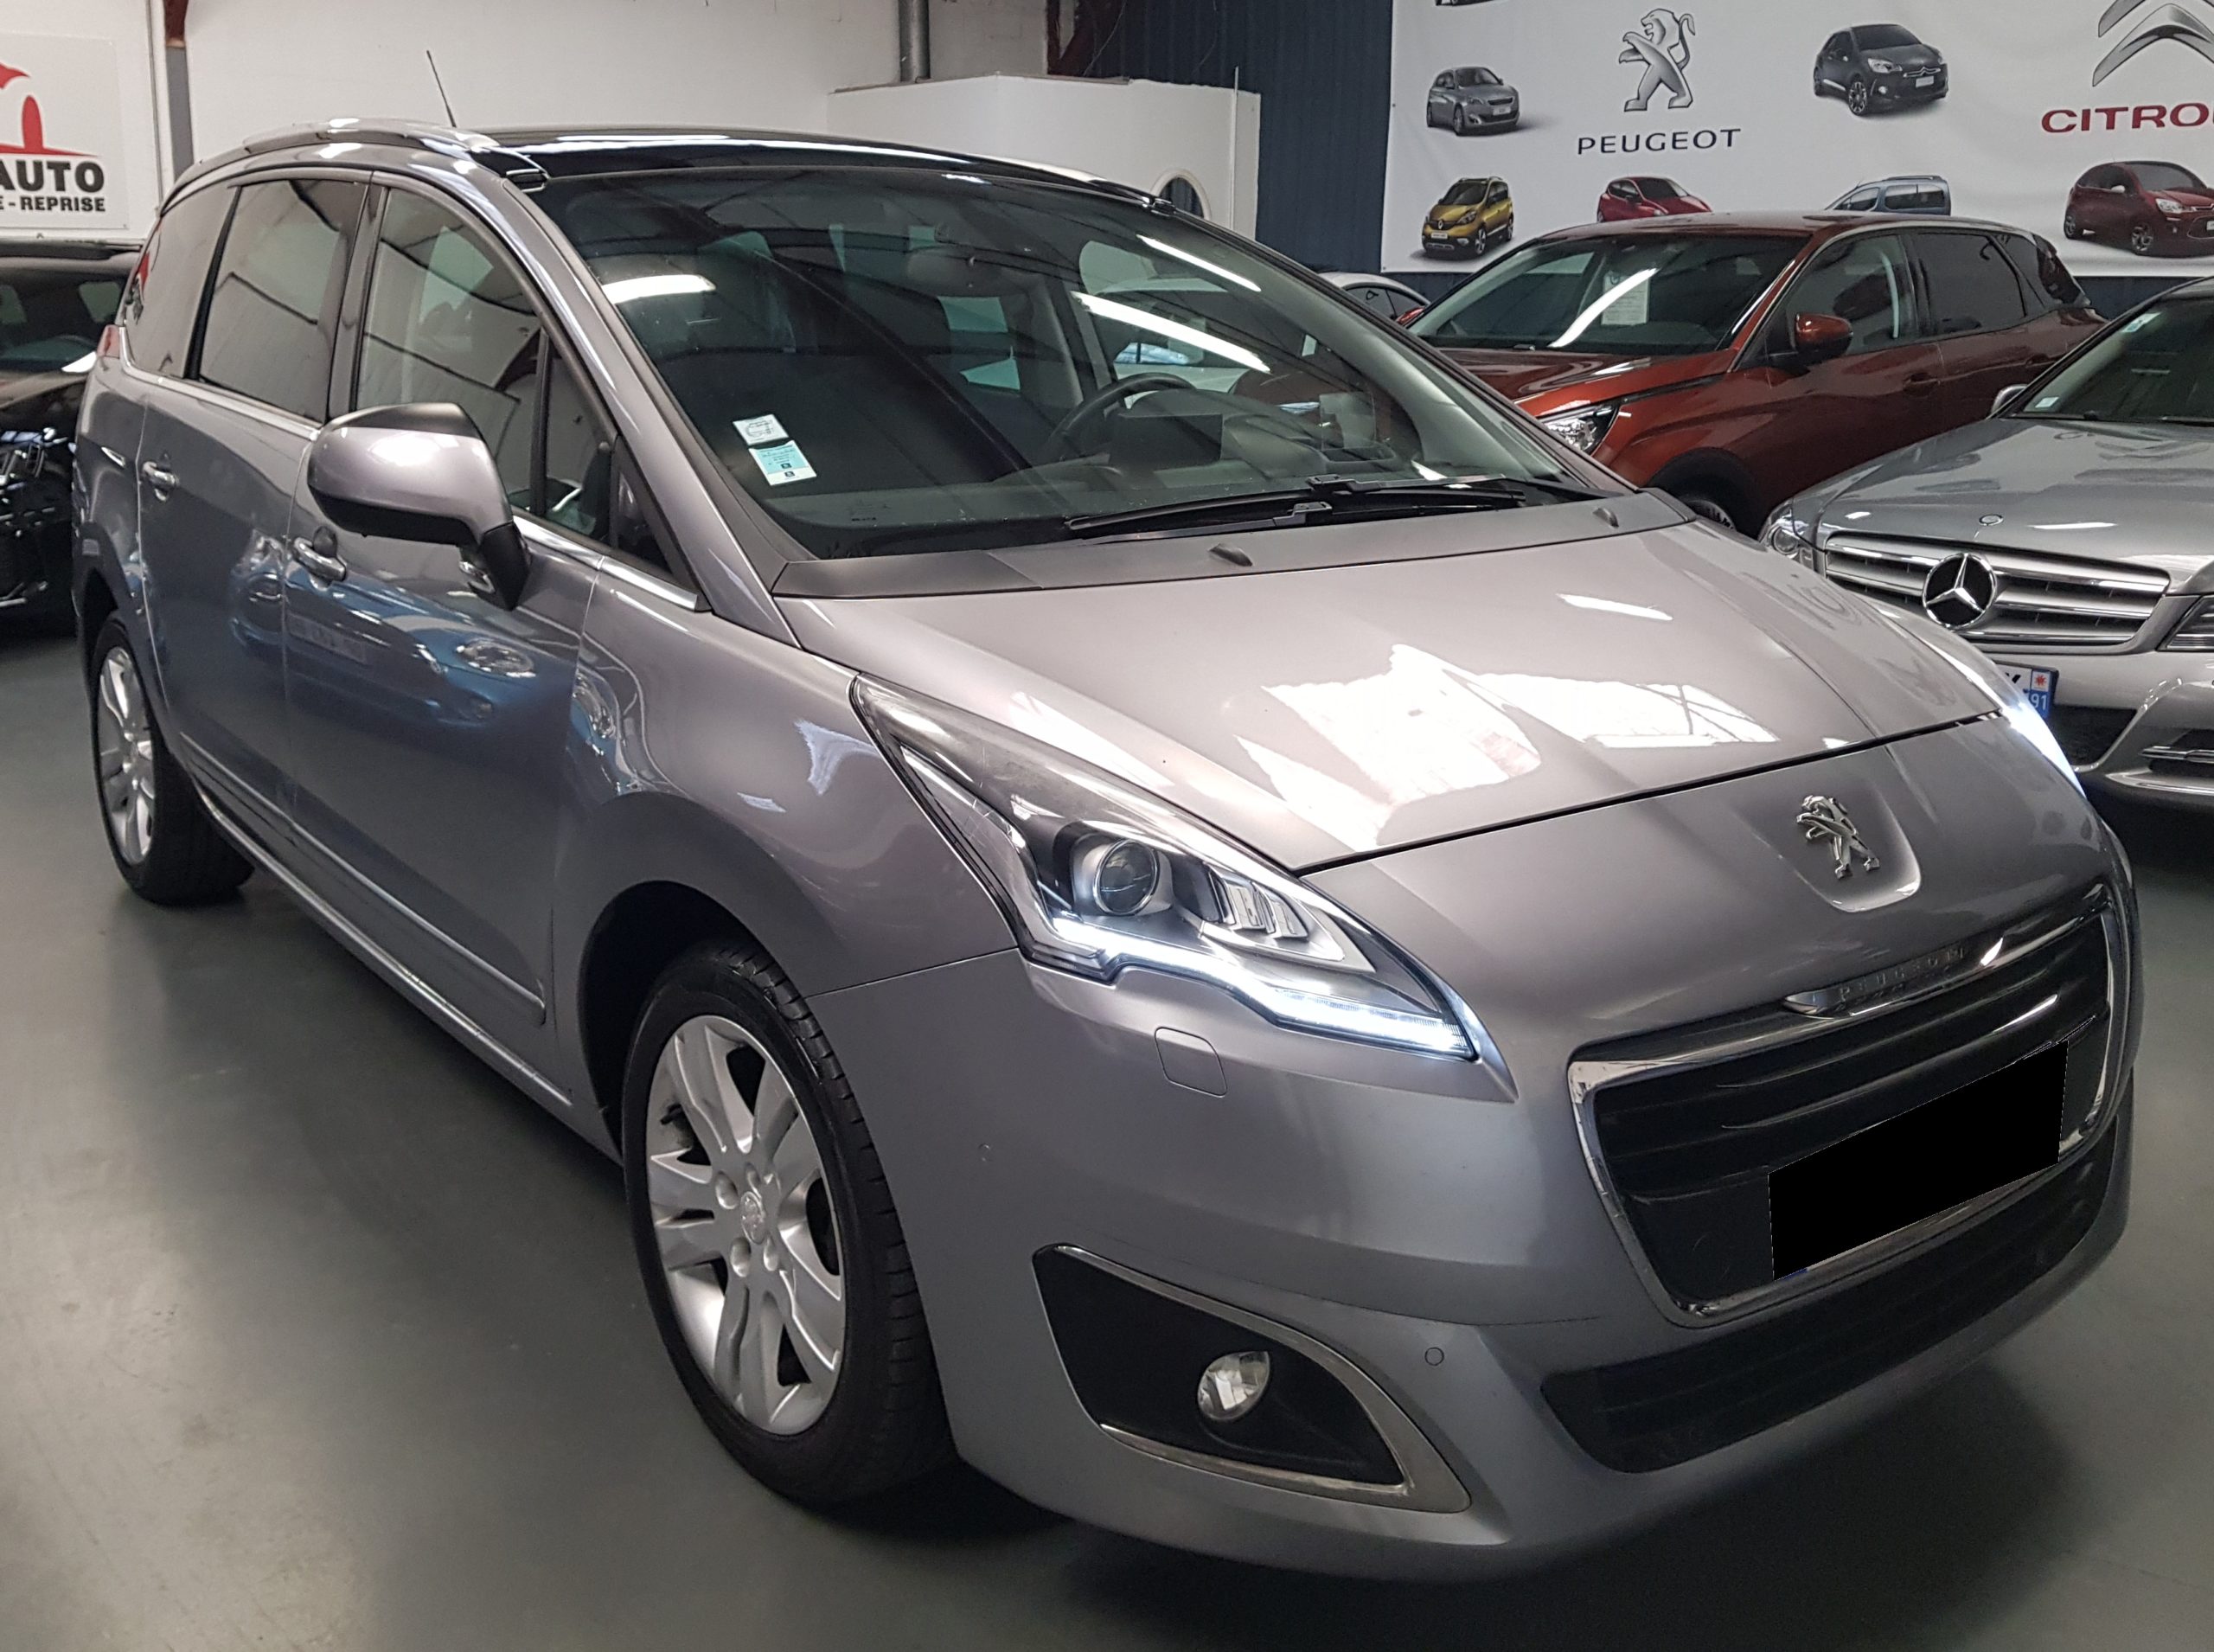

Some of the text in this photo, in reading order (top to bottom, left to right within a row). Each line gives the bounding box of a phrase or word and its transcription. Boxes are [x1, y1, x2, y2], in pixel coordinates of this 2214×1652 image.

[2041, 102, 2214, 133] CITRO
[1577, 128, 1741, 155] PEUGEOT
[2031, 693, 2047, 710] 91
